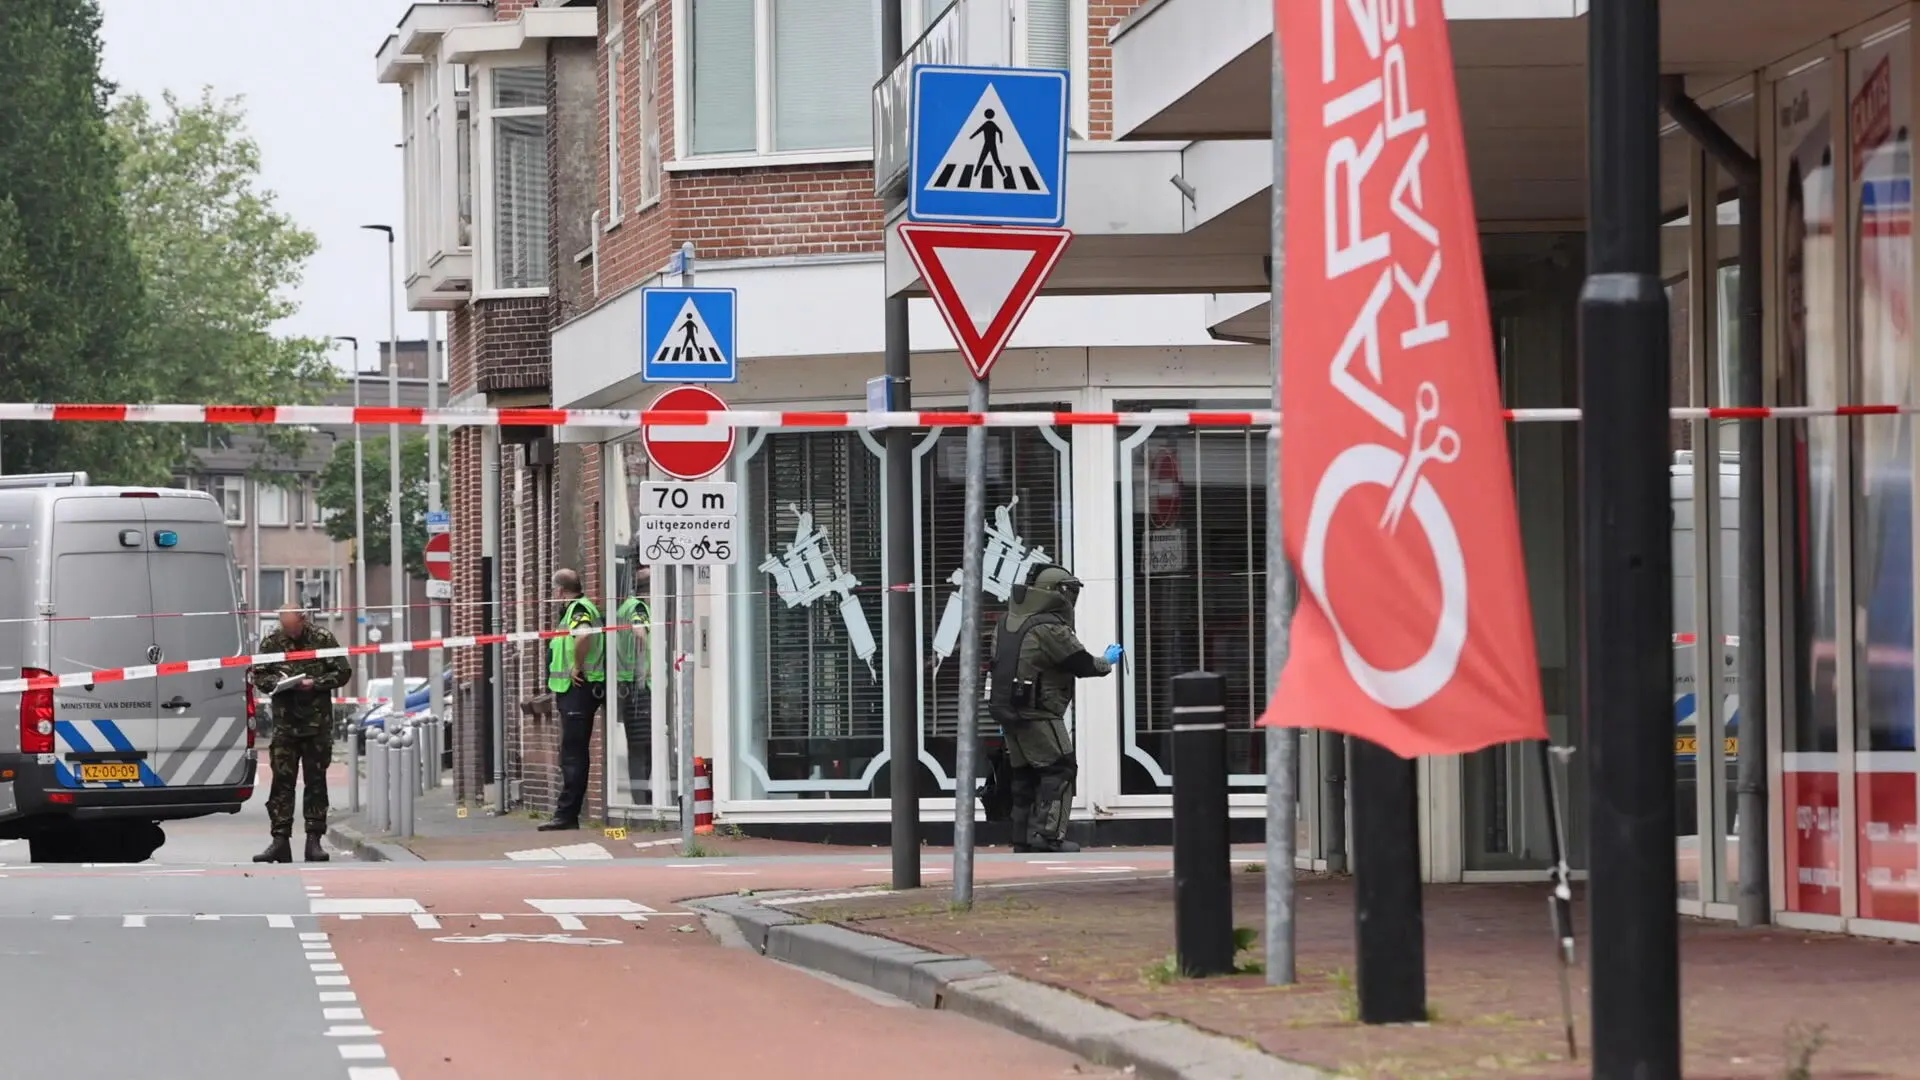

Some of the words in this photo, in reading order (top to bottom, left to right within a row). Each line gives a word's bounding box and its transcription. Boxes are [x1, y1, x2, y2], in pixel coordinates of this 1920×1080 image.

[653, 488, 688, 509] 70
[702, 493, 724, 509] m
[646, 519, 730, 532] uitgezonderd
[697, 566, 711, 580] 162
[61, 702, 102, 710] MINISTERIE
[120, 701, 153, 709] DEFENSIE
